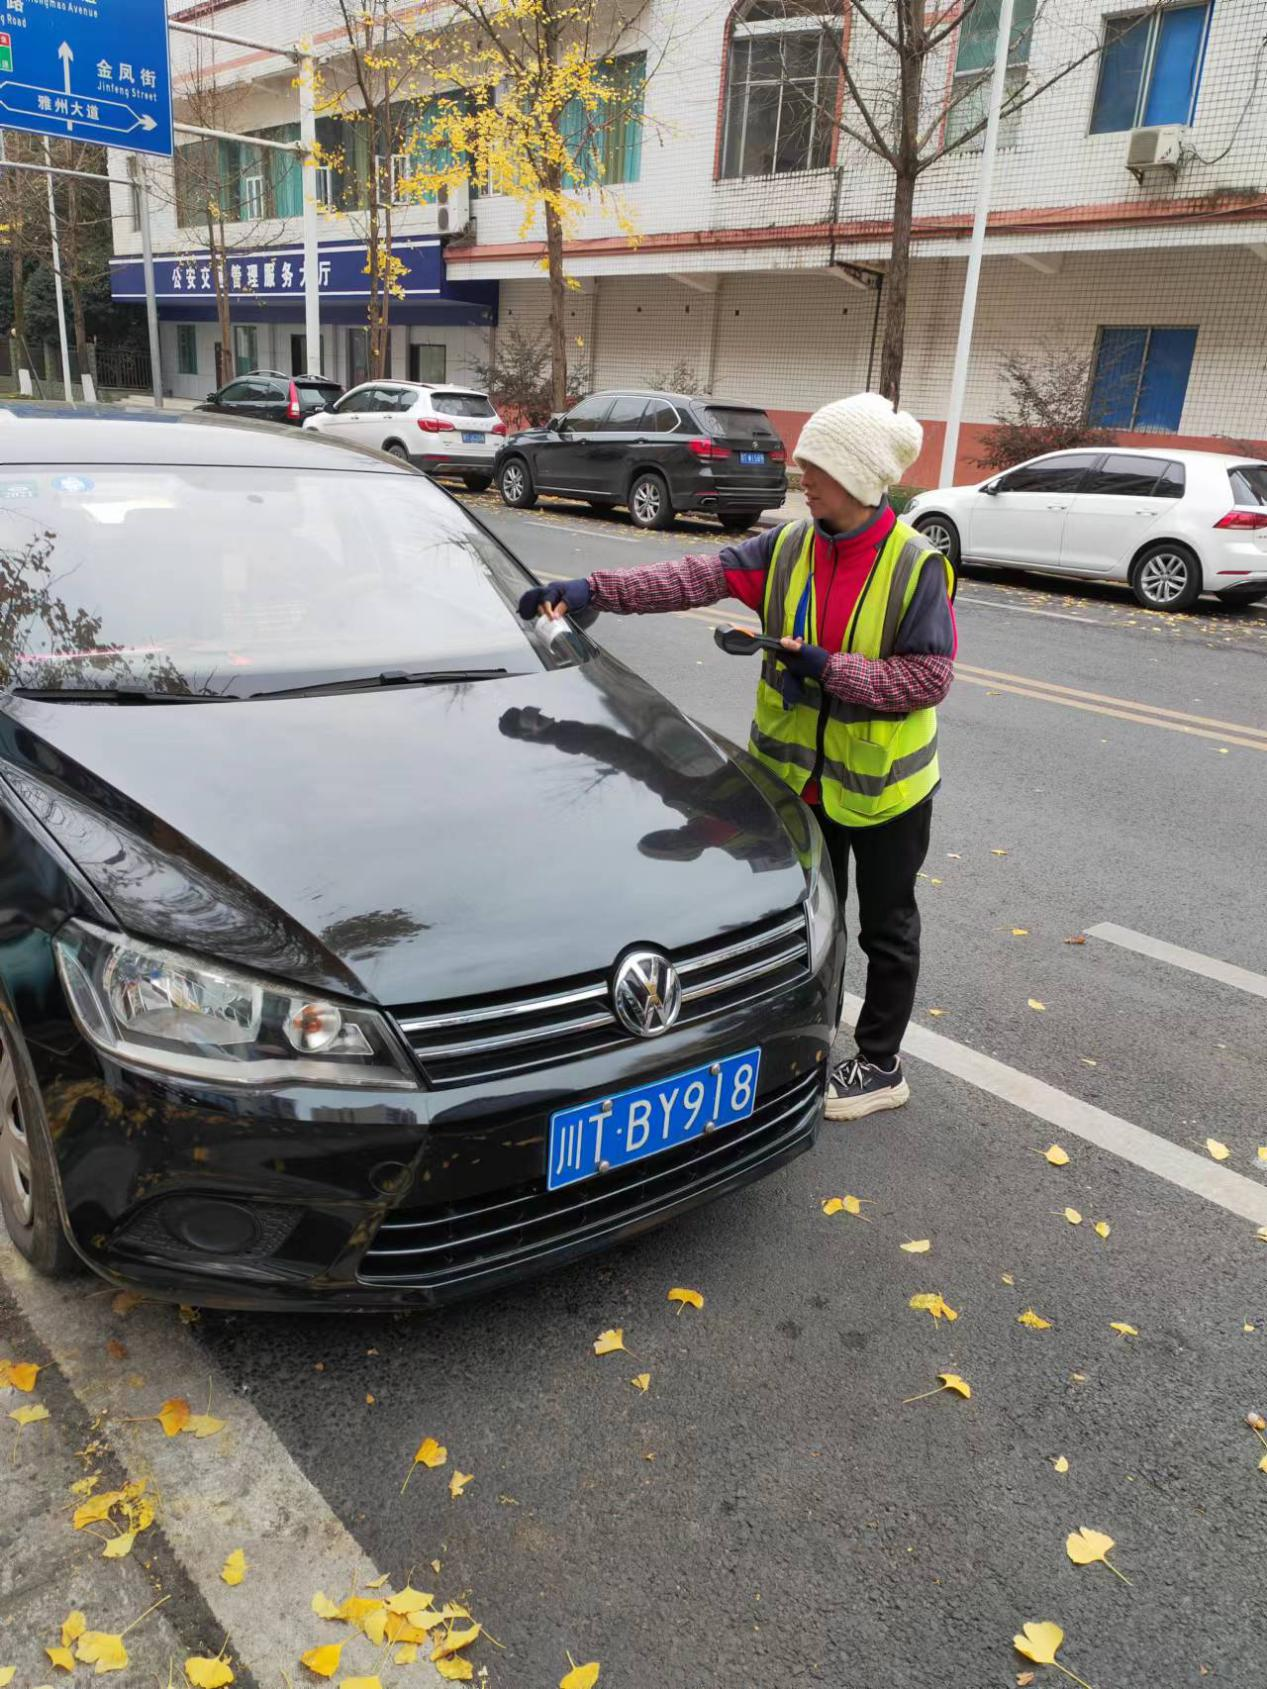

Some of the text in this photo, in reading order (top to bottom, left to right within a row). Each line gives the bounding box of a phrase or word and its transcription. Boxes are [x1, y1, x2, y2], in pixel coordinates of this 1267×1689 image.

[7, 13, 27, 28] Road
[68, 3, 98, 18] Avenue
[96, 59, 157, 89] 金凤街
[97, 80, 157, 102] Jinfeng Street
[38, 94, 99, 120] 雅州大道
